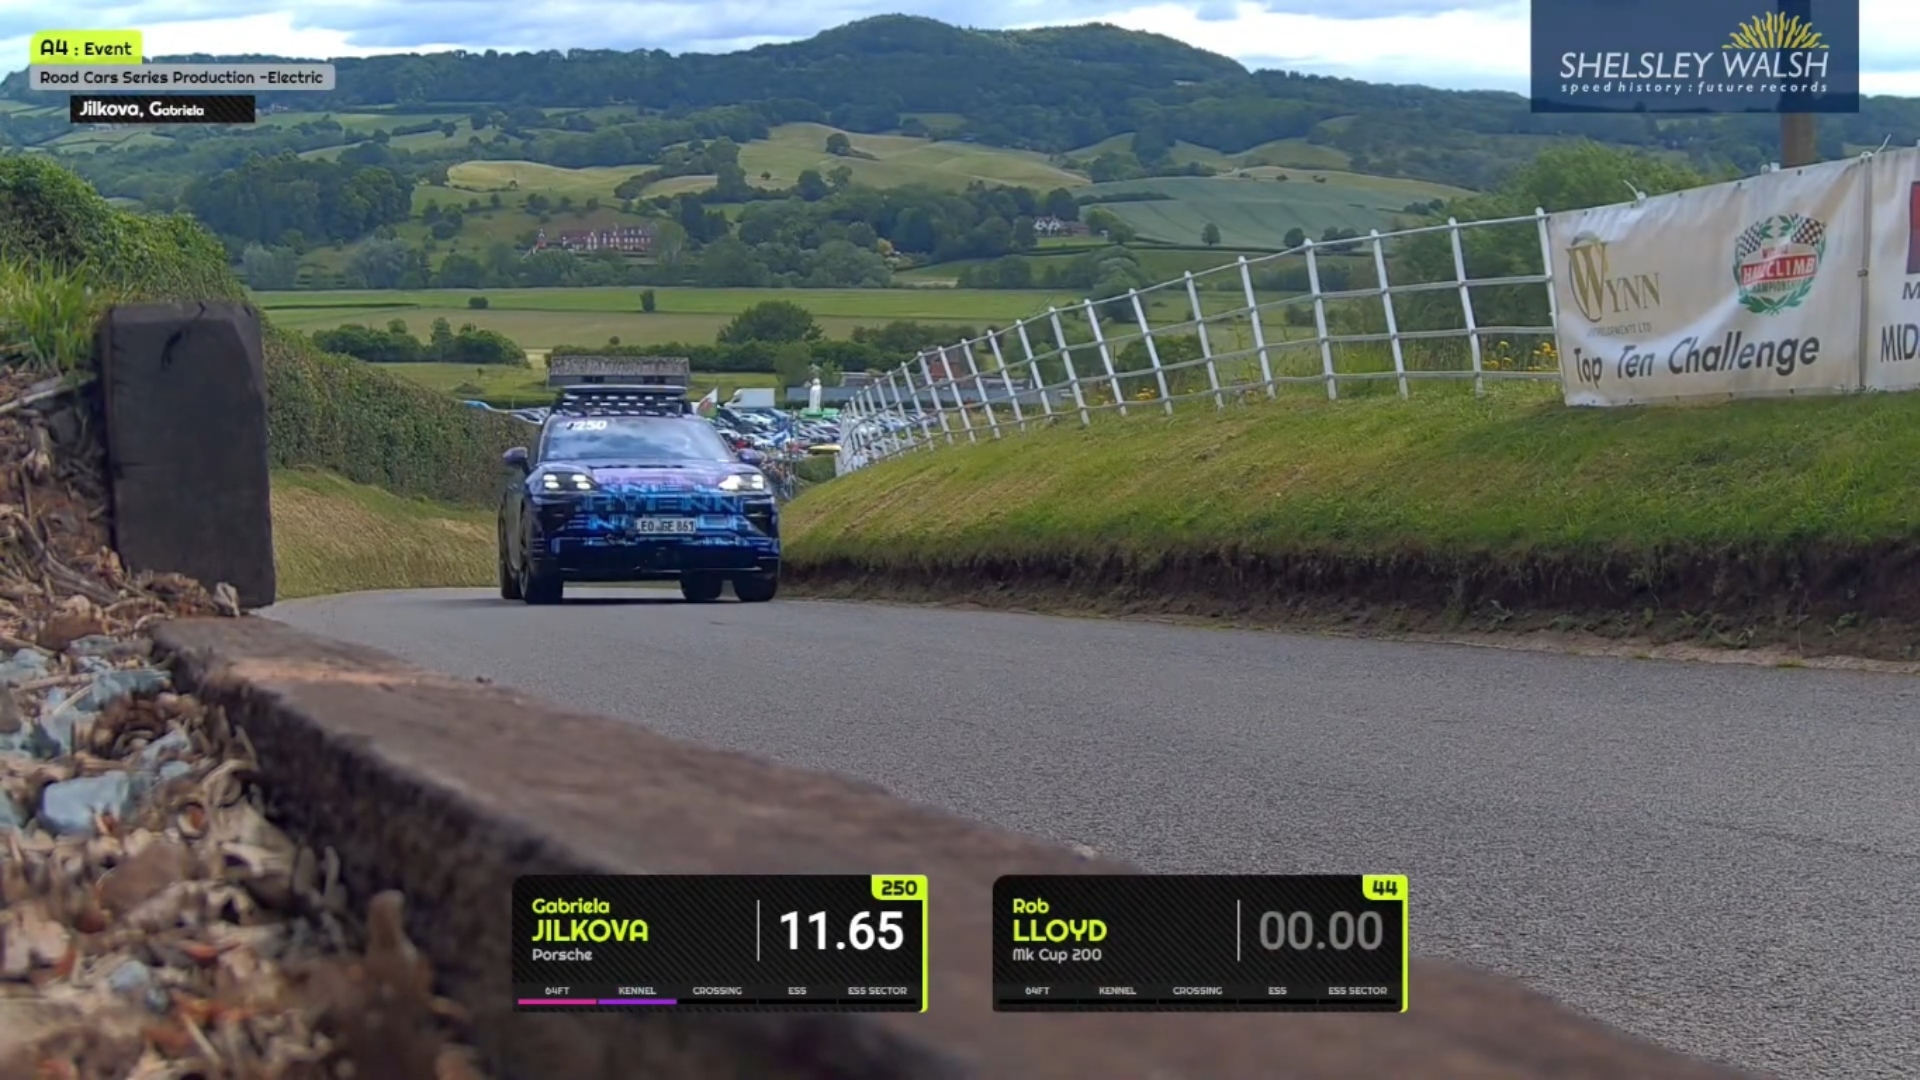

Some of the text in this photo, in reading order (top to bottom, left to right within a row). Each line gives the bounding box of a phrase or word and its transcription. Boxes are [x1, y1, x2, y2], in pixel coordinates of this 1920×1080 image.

[1565, 242, 1661, 320] WYNN
[1574, 331, 1820, 389] Top Ten Challenge
[1880, 323, 1920, 363] MID
